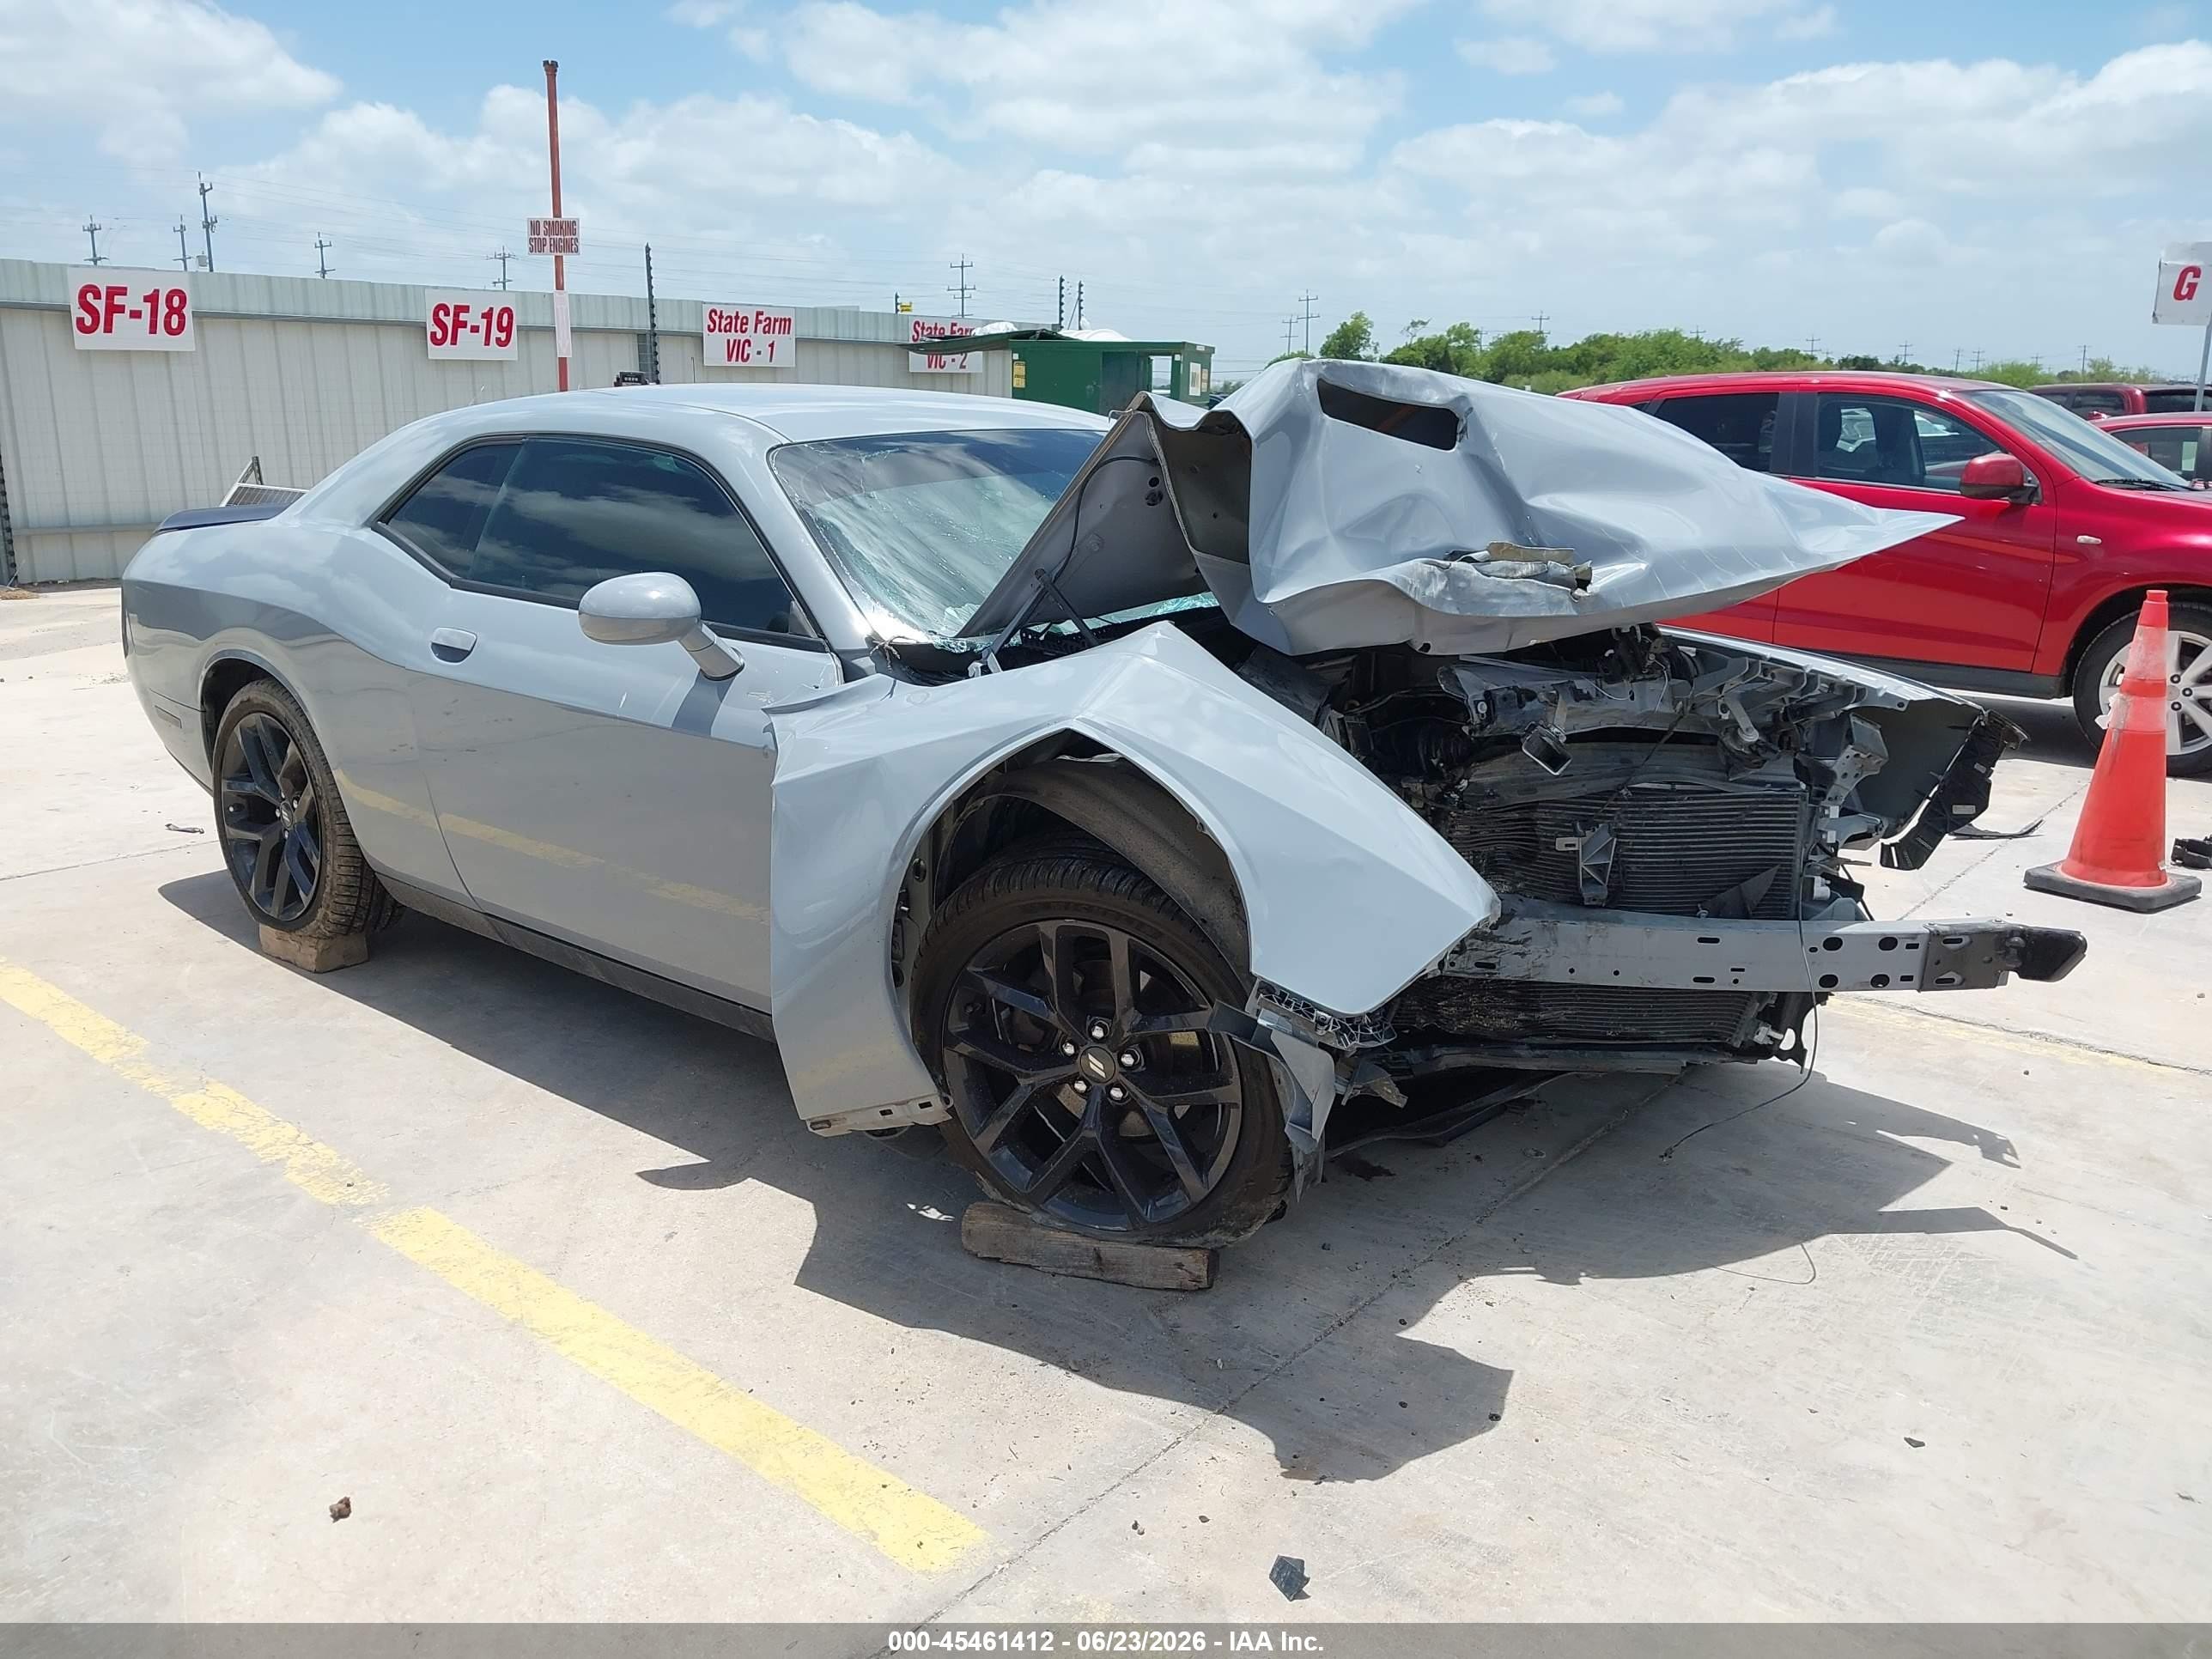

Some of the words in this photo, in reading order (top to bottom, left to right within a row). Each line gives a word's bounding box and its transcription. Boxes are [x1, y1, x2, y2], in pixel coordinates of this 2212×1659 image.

[530, 220, 541, 236] NO
[543, 220, 577, 236] SMOKING
[528, 237, 547, 253] STOP
[549, 237, 579, 253] ENGINES
[2172, 265, 2202, 301] G
[75, 283, 188, 337] SF-18
[707, 308, 749, 334] State
[753, 310, 792, 335] Farm
[429, 302, 514, 348] SF-19
[726, 338, 751, 362] VIC
[768, 340, 775, 362] 1
[927, 353, 946, 369] VIC
[959, 352, 968, 369] 2
